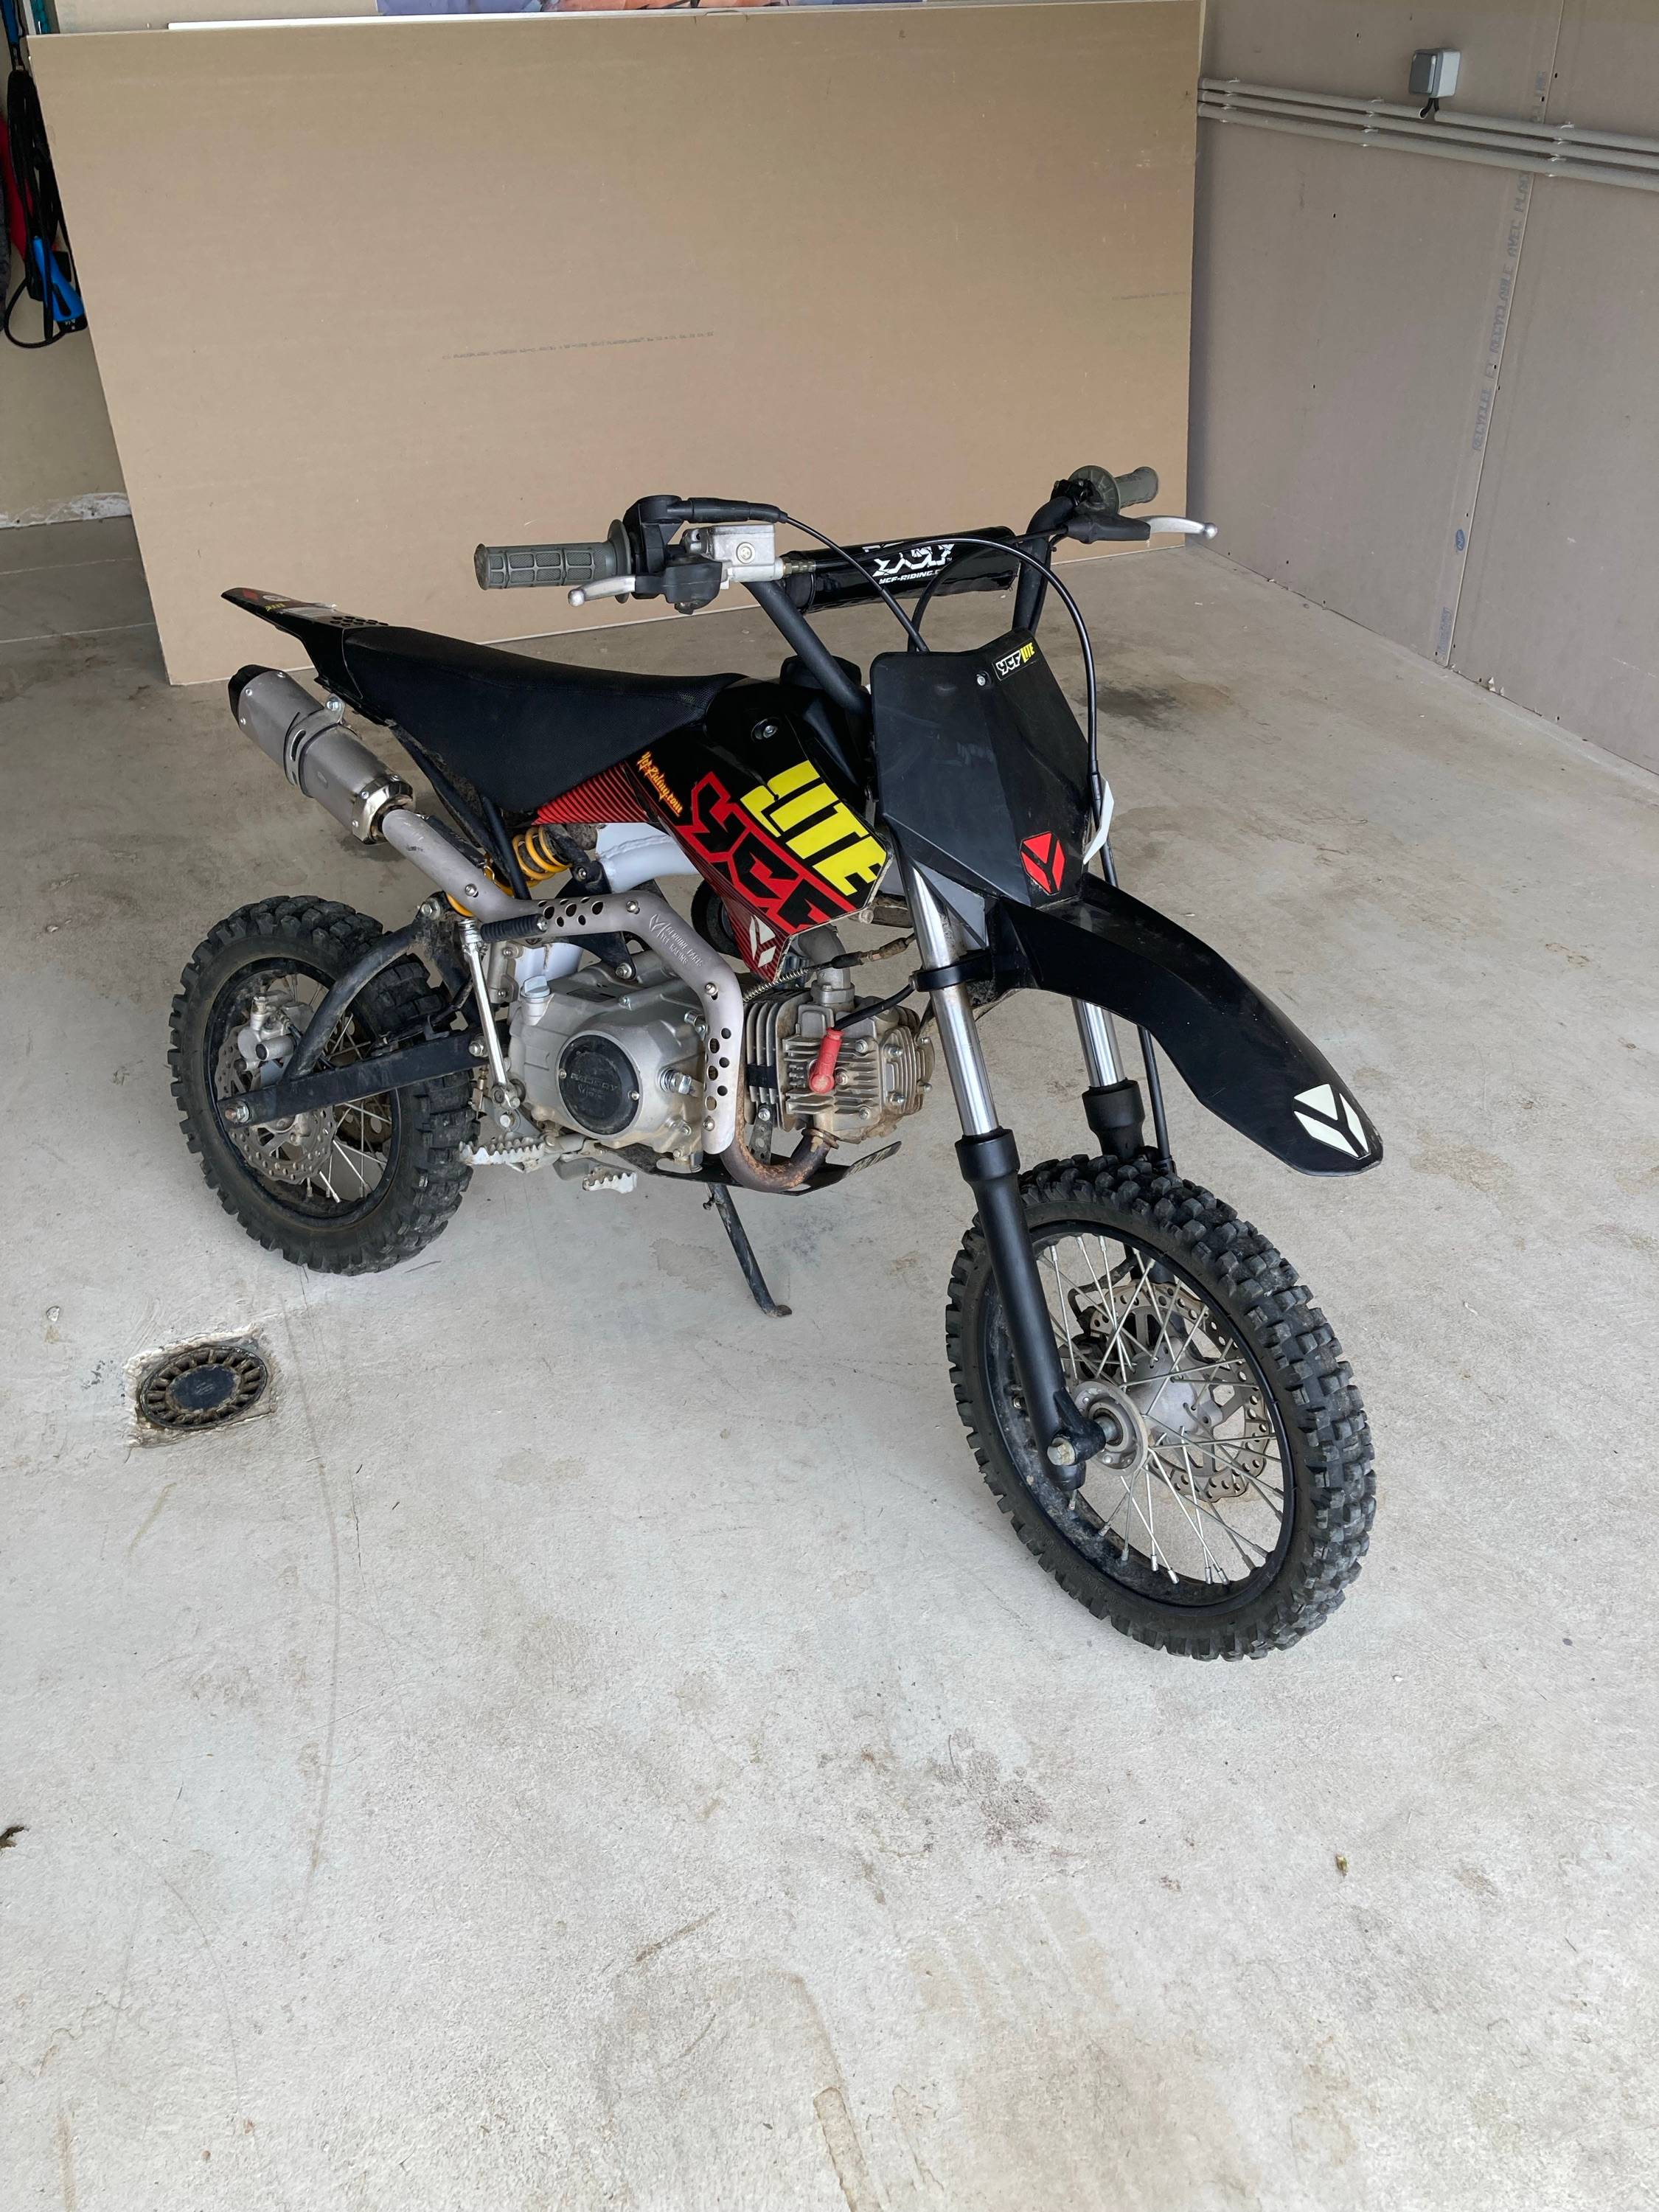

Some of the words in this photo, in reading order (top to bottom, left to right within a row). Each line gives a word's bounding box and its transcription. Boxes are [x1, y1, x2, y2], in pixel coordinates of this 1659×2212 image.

[1506, 220, 1523, 258] AVEC
[995, 650, 1021, 675] YCF
[1020, 642, 1035, 663] LITE
[686, 771, 858, 936] YCF
[740, 760, 886, 896] LITE
